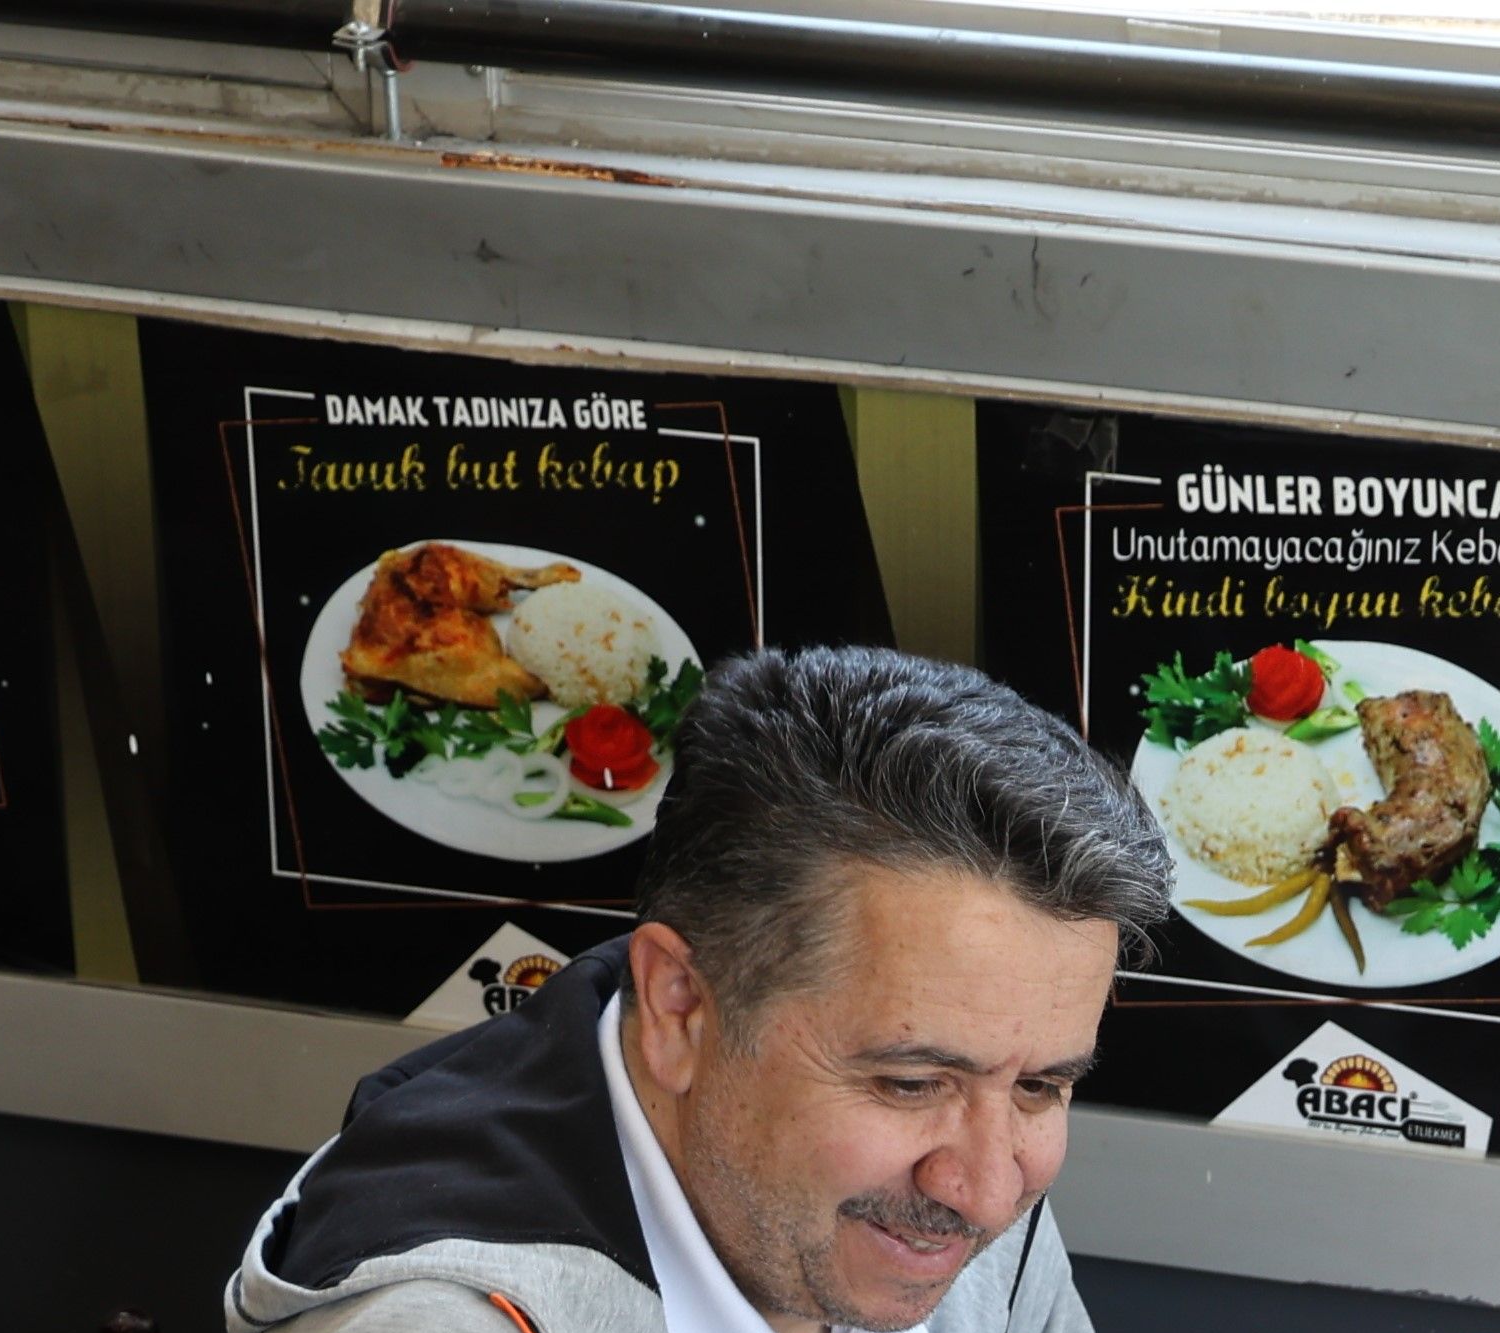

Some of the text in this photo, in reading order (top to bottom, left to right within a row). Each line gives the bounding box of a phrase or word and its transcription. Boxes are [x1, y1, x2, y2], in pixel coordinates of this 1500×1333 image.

[325, 392, 647, 430] DAMAK TADINIZA GÖRE
[277, 440, 680, 504] Tavuk but kebap
[1177, 463, 1323, 516] GÜNLER
[1112, 527, 1422, 572] Unutamayacağınız
[1263, 574, 1401, 630] boyun
[1296, 1086, 1411, 1122] ABACI
